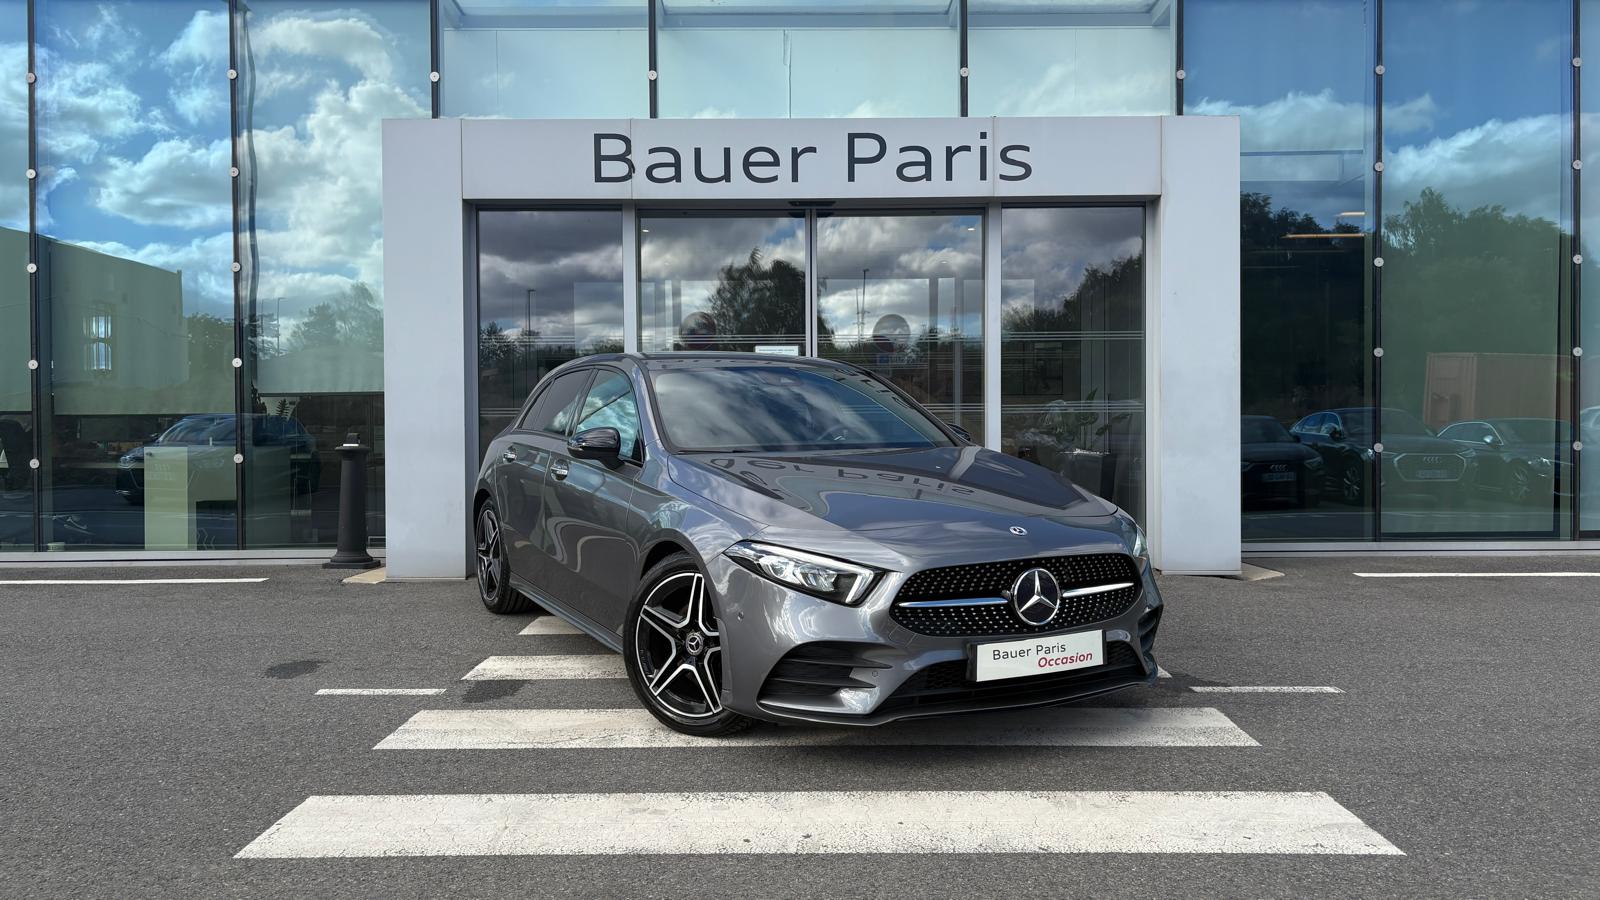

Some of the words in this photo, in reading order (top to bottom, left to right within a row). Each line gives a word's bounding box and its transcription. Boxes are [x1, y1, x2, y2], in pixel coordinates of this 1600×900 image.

[593, 132, 818, 183] Bauer
[846, 131, 1033, 182] Paris
[993, 648, 1032, 661] Bauer
[1036, 643, 1066, 655] Paris
[1038, 652, 1093, 668] Occasion
